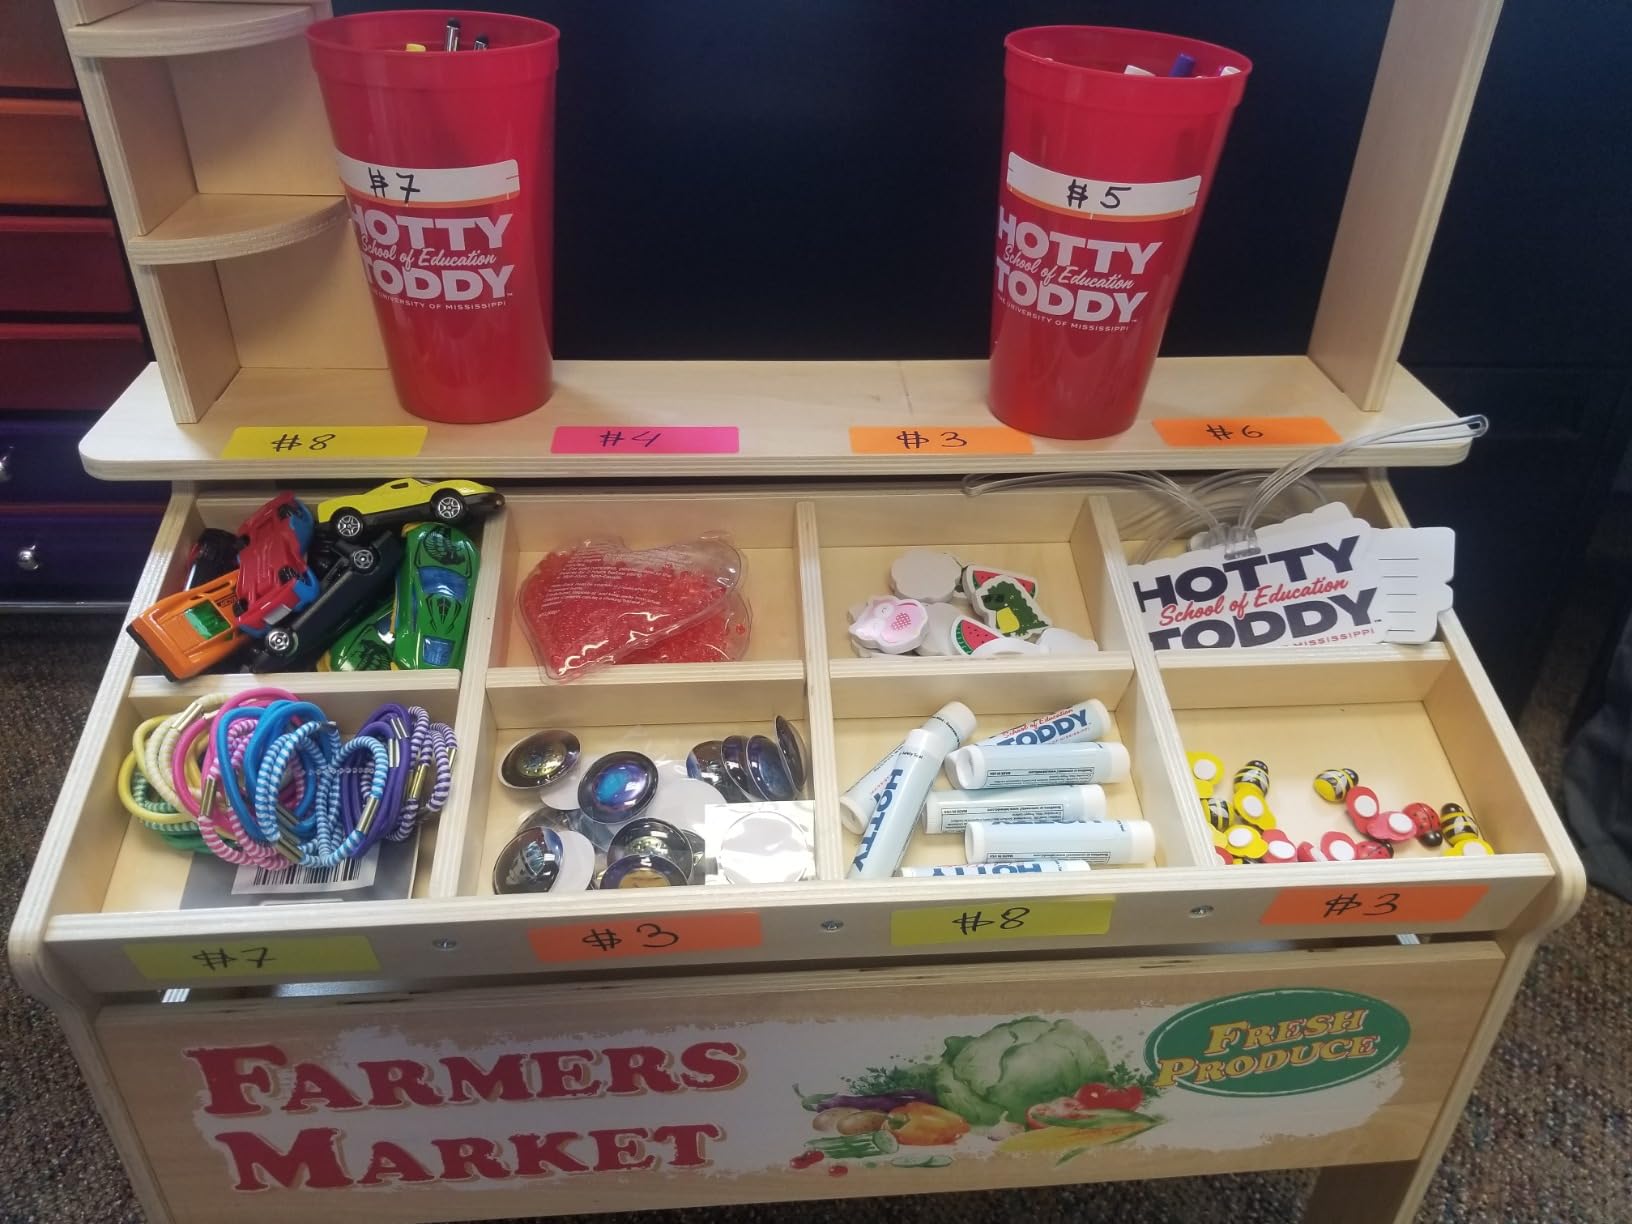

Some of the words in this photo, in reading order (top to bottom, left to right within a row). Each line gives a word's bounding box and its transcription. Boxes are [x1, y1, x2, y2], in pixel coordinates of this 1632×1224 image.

[350, 203, 513, 251] HOTTY
[998, 205, 1163, 275] HOTTY
[361, 234, 397, 261] School
[400, 249, 415, 272] of
[418, 248, 497, 267] Education
[362, 253, 514, 301] TODDY
[1002, 245, 1041, 272] School
[1041, 265, 1056, 286] of
[1058, 265, 1135, 290] Education
[445, 300, 507, 311] MISSISSIPPI
[996, 256, 1148, 323] TODDY
[1055, 319, 1068, 327] OF
[1070, 322, 1129, 332] MISSISSIPPI
[1132, 535, 1360, 613] HOTTY
[1148, 586, 1377, 651] TODDY
[1159, 595, 1225, 627] School
[1229, 592, 1249, 621] of
[1254, 576, 1349, 609] Education
[997, 709, 1087, 746] TODDY
[853, 769, 904, 872] HOTTY
[1204, 1008, 1369, 1056] FRESH
[183, 1042, 746, 1115] FARMERS
[1153, 1035, 1381, 1088] PRODUCE
[214, 1123, 725, 1191] MARKET
